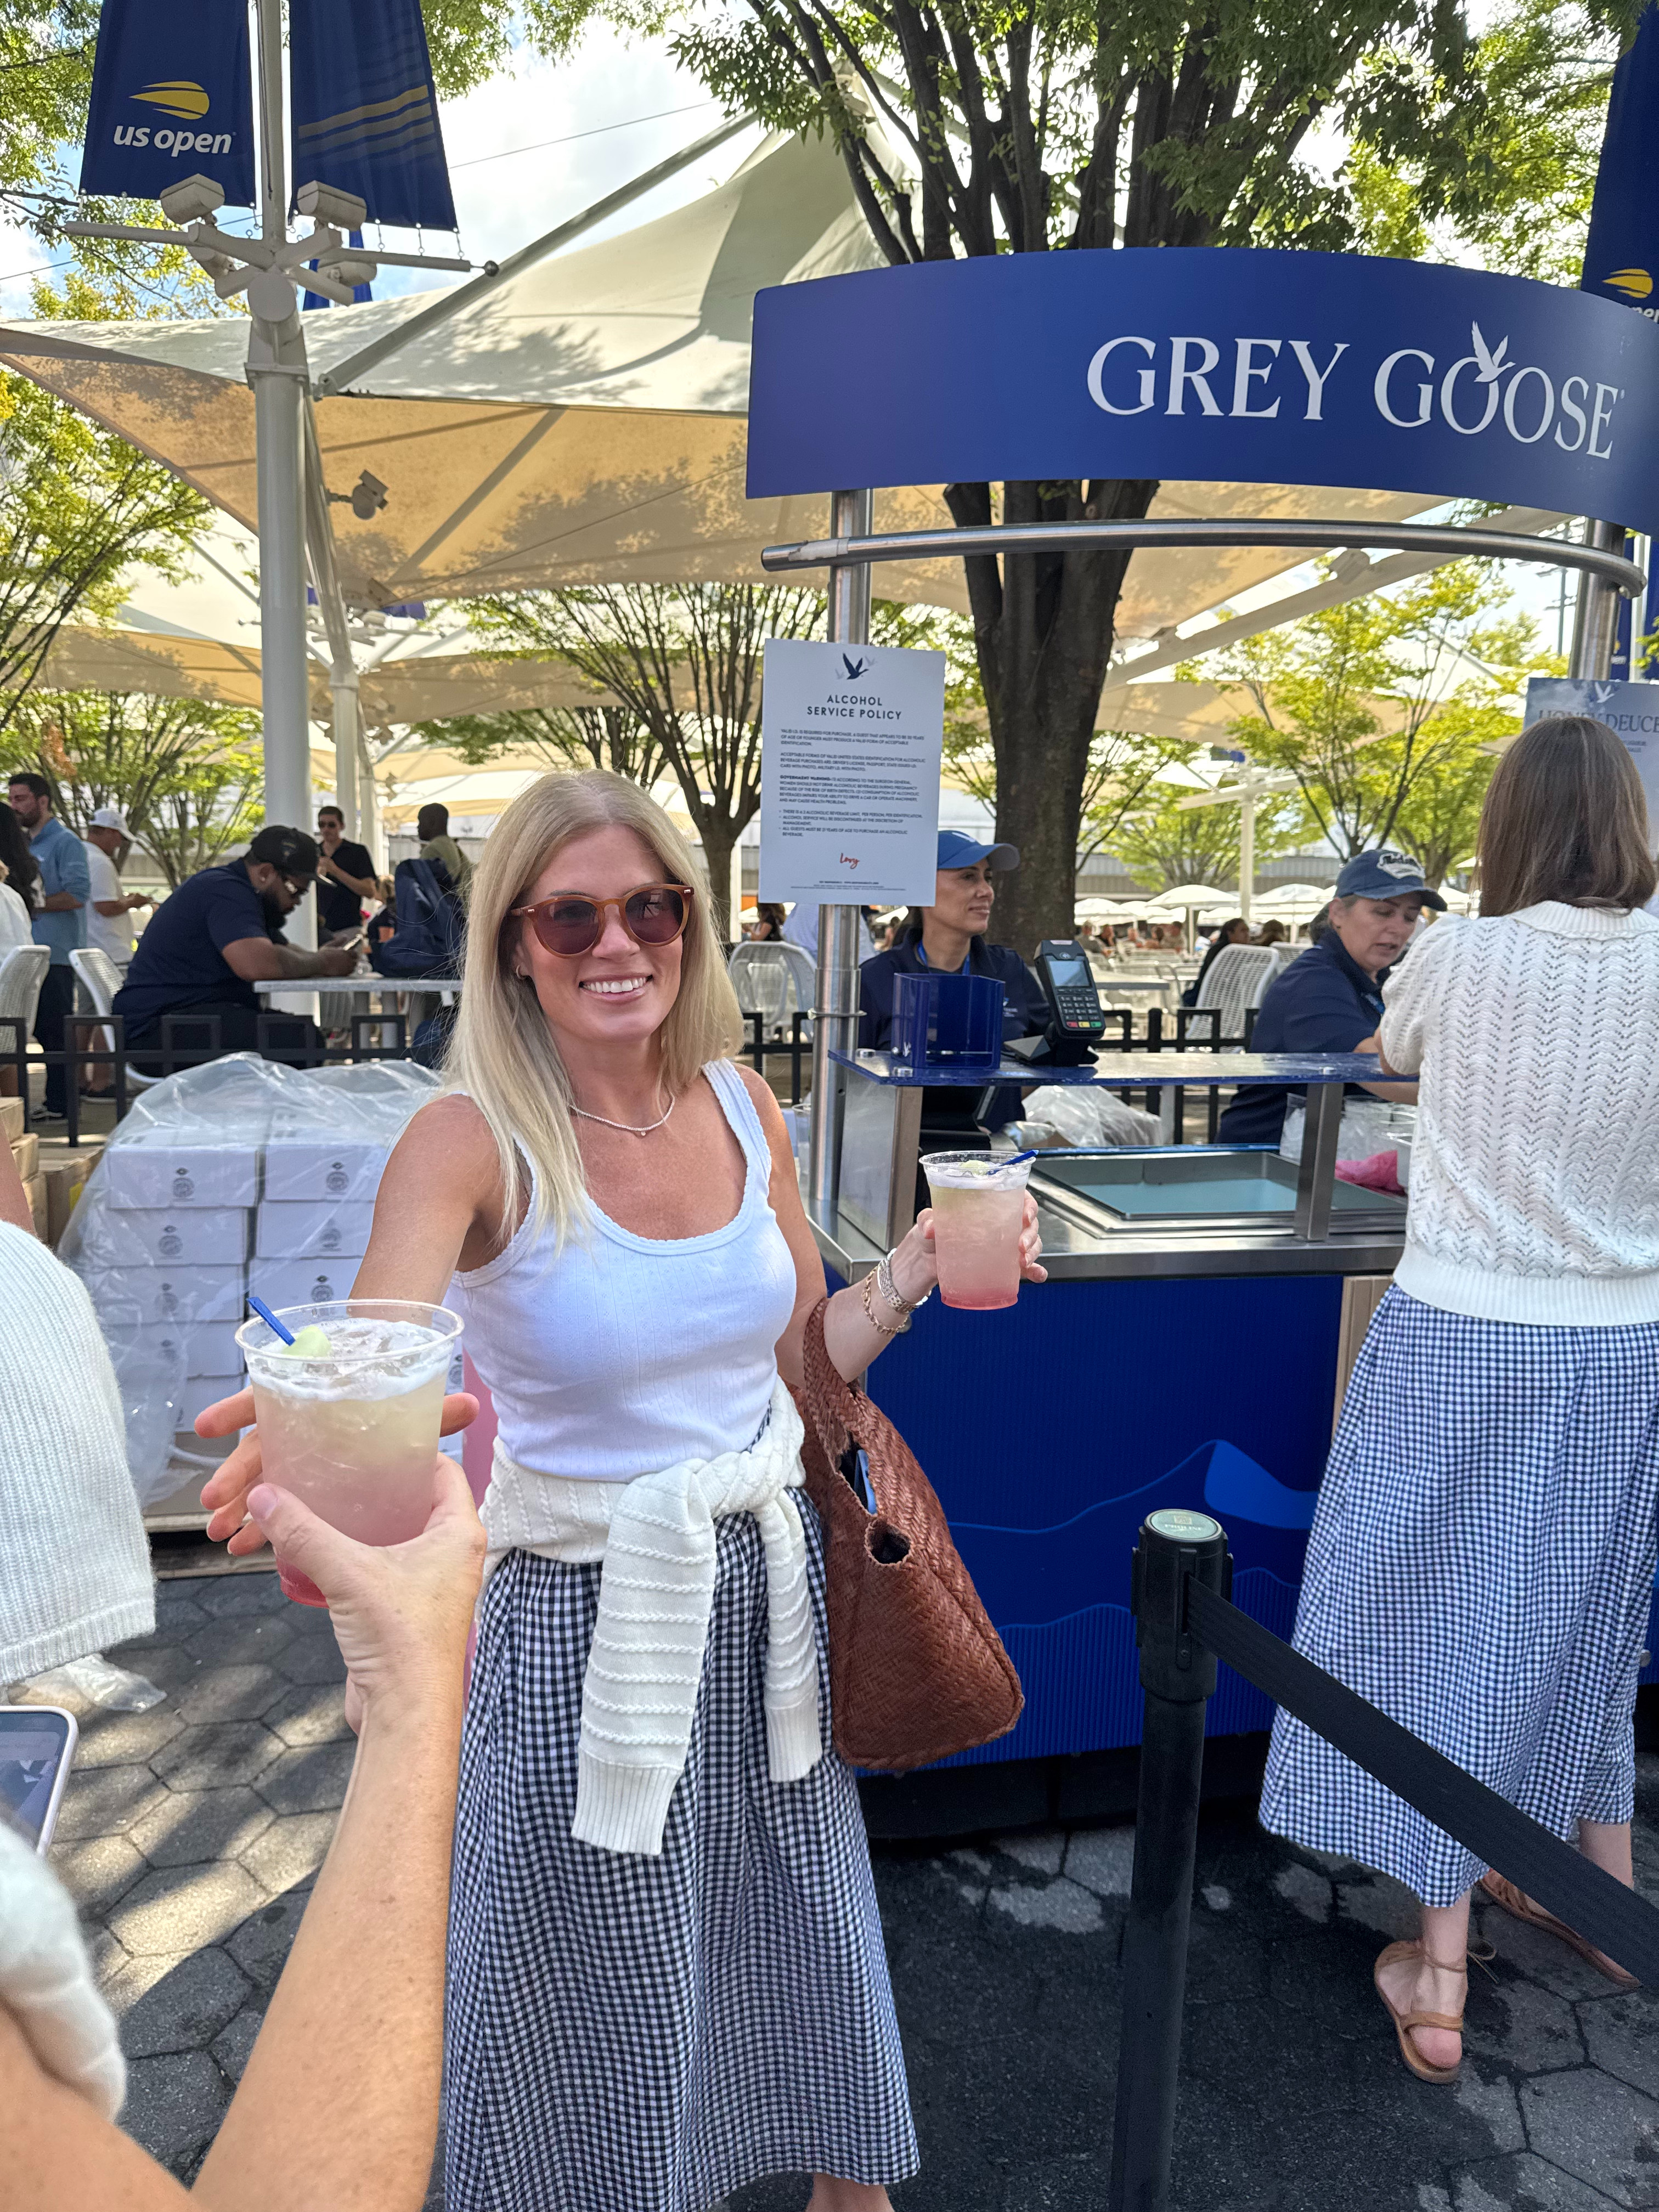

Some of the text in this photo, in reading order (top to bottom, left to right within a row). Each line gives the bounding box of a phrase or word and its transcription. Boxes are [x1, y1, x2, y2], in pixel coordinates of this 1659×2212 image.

[114, 125, 232, 157] us open
[1087, 336, 1619, 460] GREY GOOSE
[827, 695, 883, 706] ALCOHOL
[807, 706, 902, 720] SERVICE POLICY
